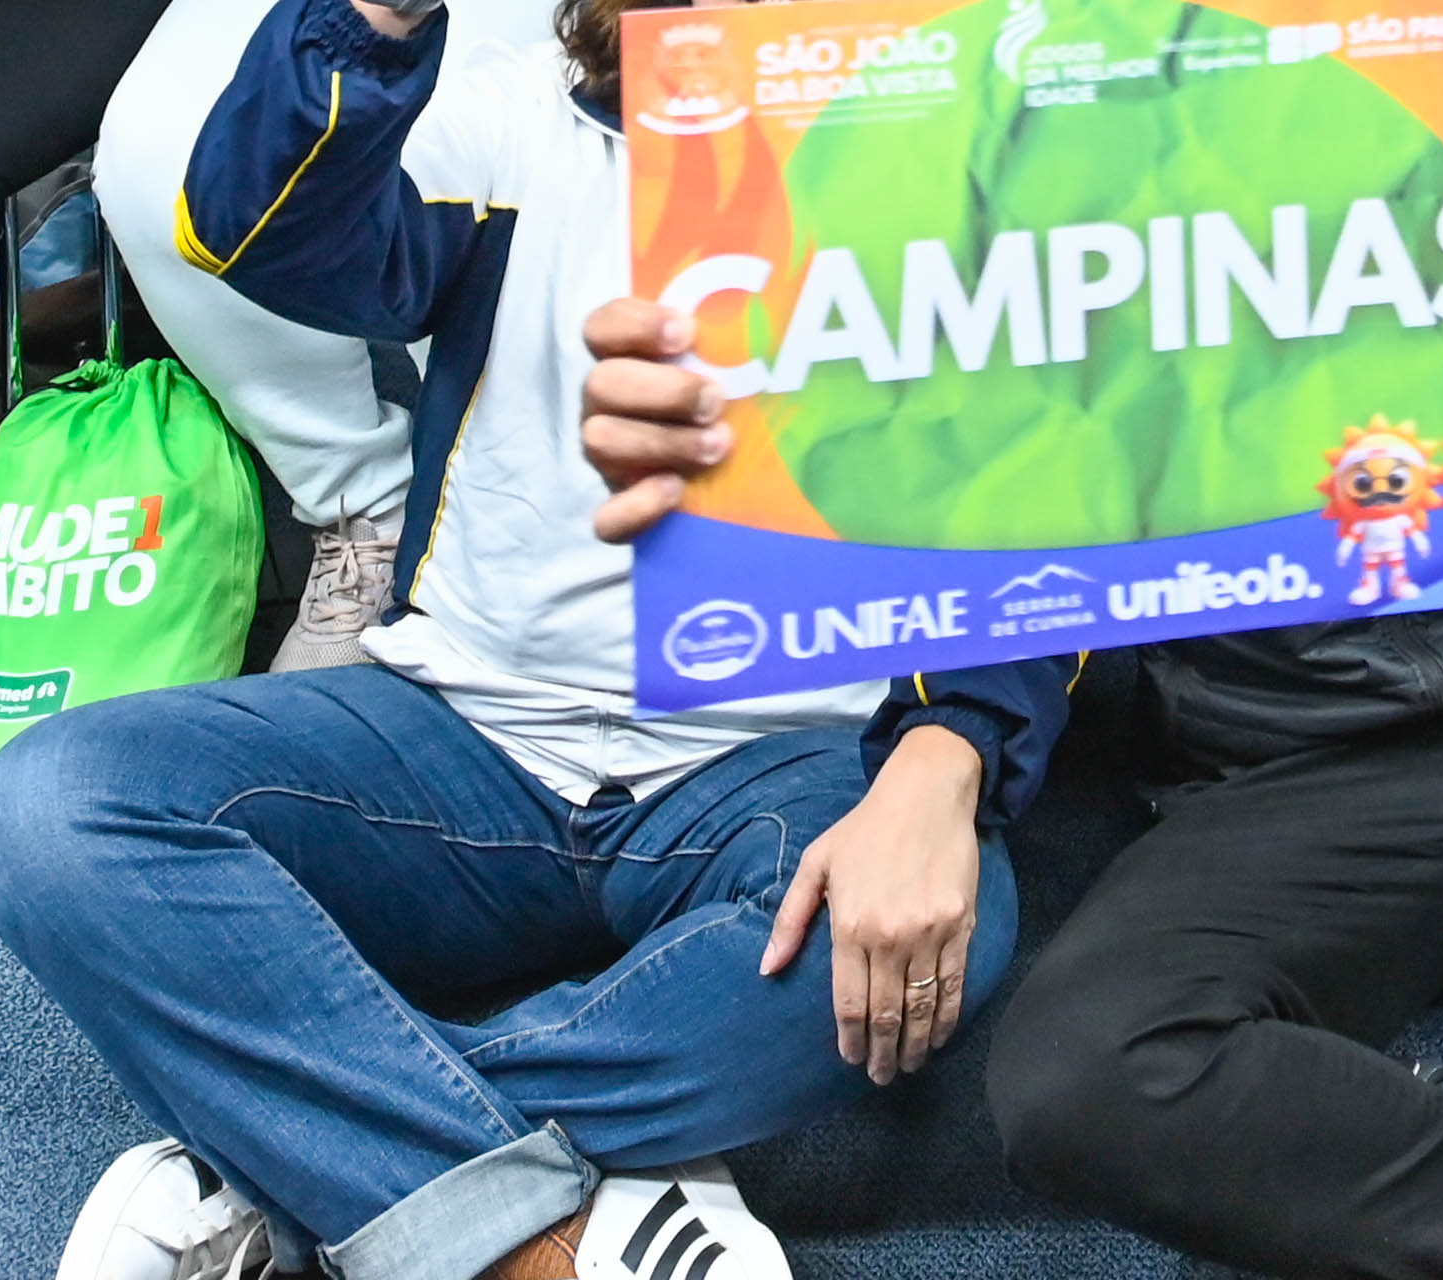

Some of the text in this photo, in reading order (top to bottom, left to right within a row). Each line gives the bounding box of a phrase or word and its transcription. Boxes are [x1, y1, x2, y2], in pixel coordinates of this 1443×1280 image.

[756, 26, 957, 75] SÃO JOÃO
[1346, 13, 1404, 44] SÃO
[755, 68, 957, 105] DA BOA VISTA
[1107, 553, 1324, 621] unifeob.
[781, 589, 969, 659] UNIFAE
